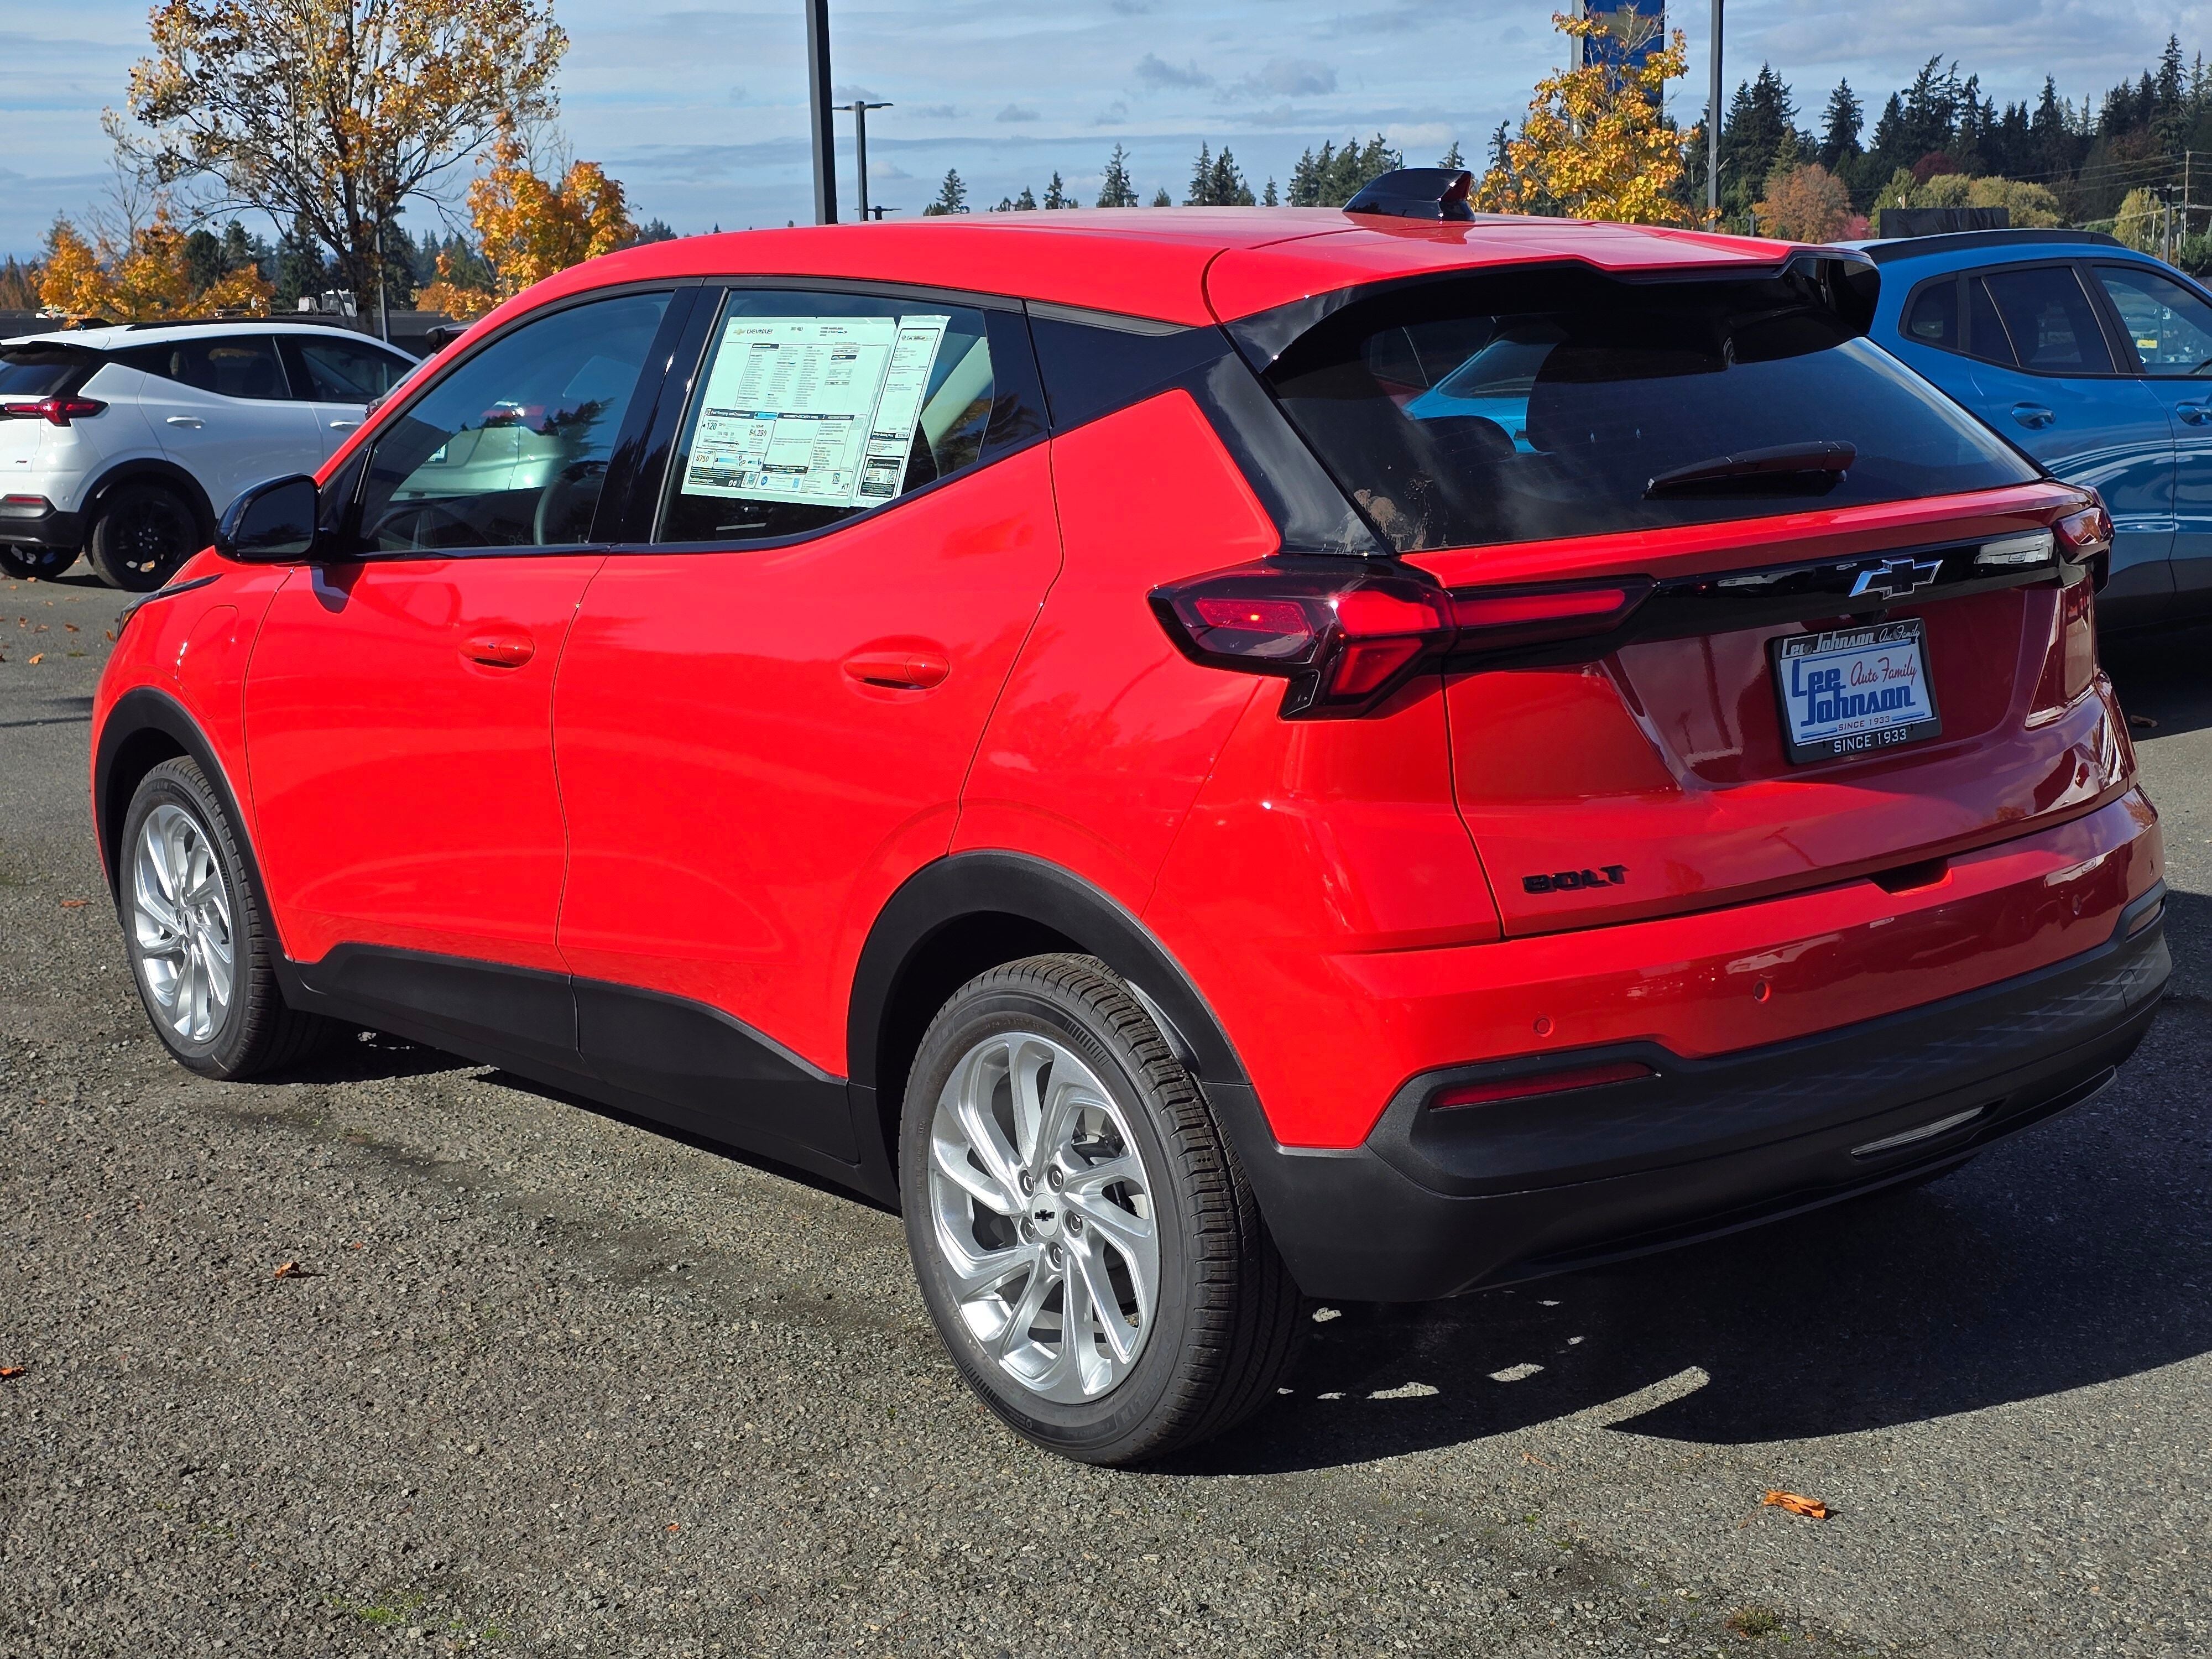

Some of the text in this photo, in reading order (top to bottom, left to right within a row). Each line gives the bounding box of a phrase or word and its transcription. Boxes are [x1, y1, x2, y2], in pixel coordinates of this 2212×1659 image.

[1781, 623, 1921, 659] Le Johnson Aut Family
[1791, 659, 1846, 698] Lee
[1850, 653, 1917, 687] Auto Family
[1800, 682, 1916, 727] Johnson
[1833, 728, 1907, 754] SINCE 1933
[1838, 716, 1890, 732] SINCE 1933
[1521, 864, 1631, 895] BOLT
